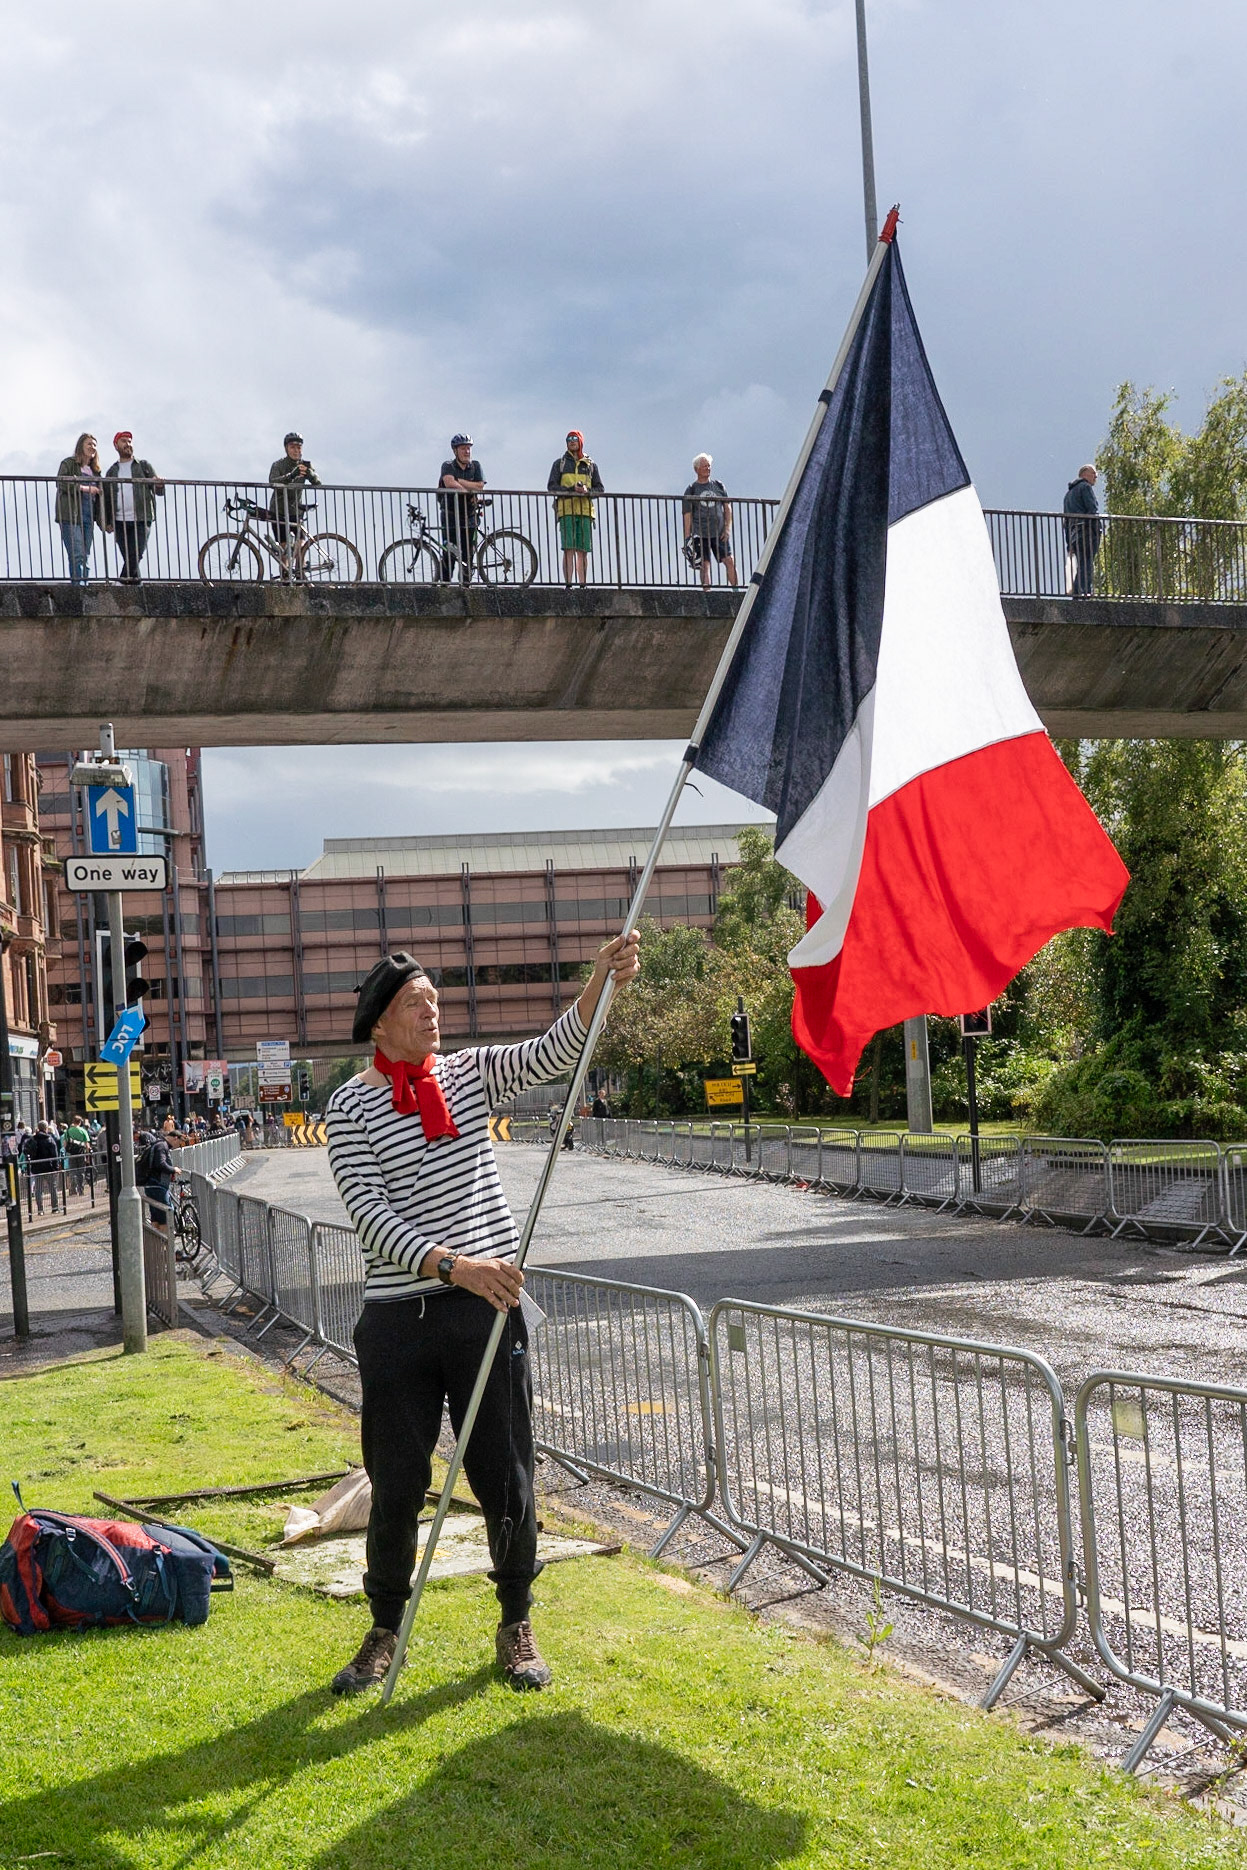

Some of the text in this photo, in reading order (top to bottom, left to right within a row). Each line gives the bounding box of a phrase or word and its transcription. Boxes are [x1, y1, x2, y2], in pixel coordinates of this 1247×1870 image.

[74, 865, 158, 883] One way
[111, 1024, 134, 1054] LOC
